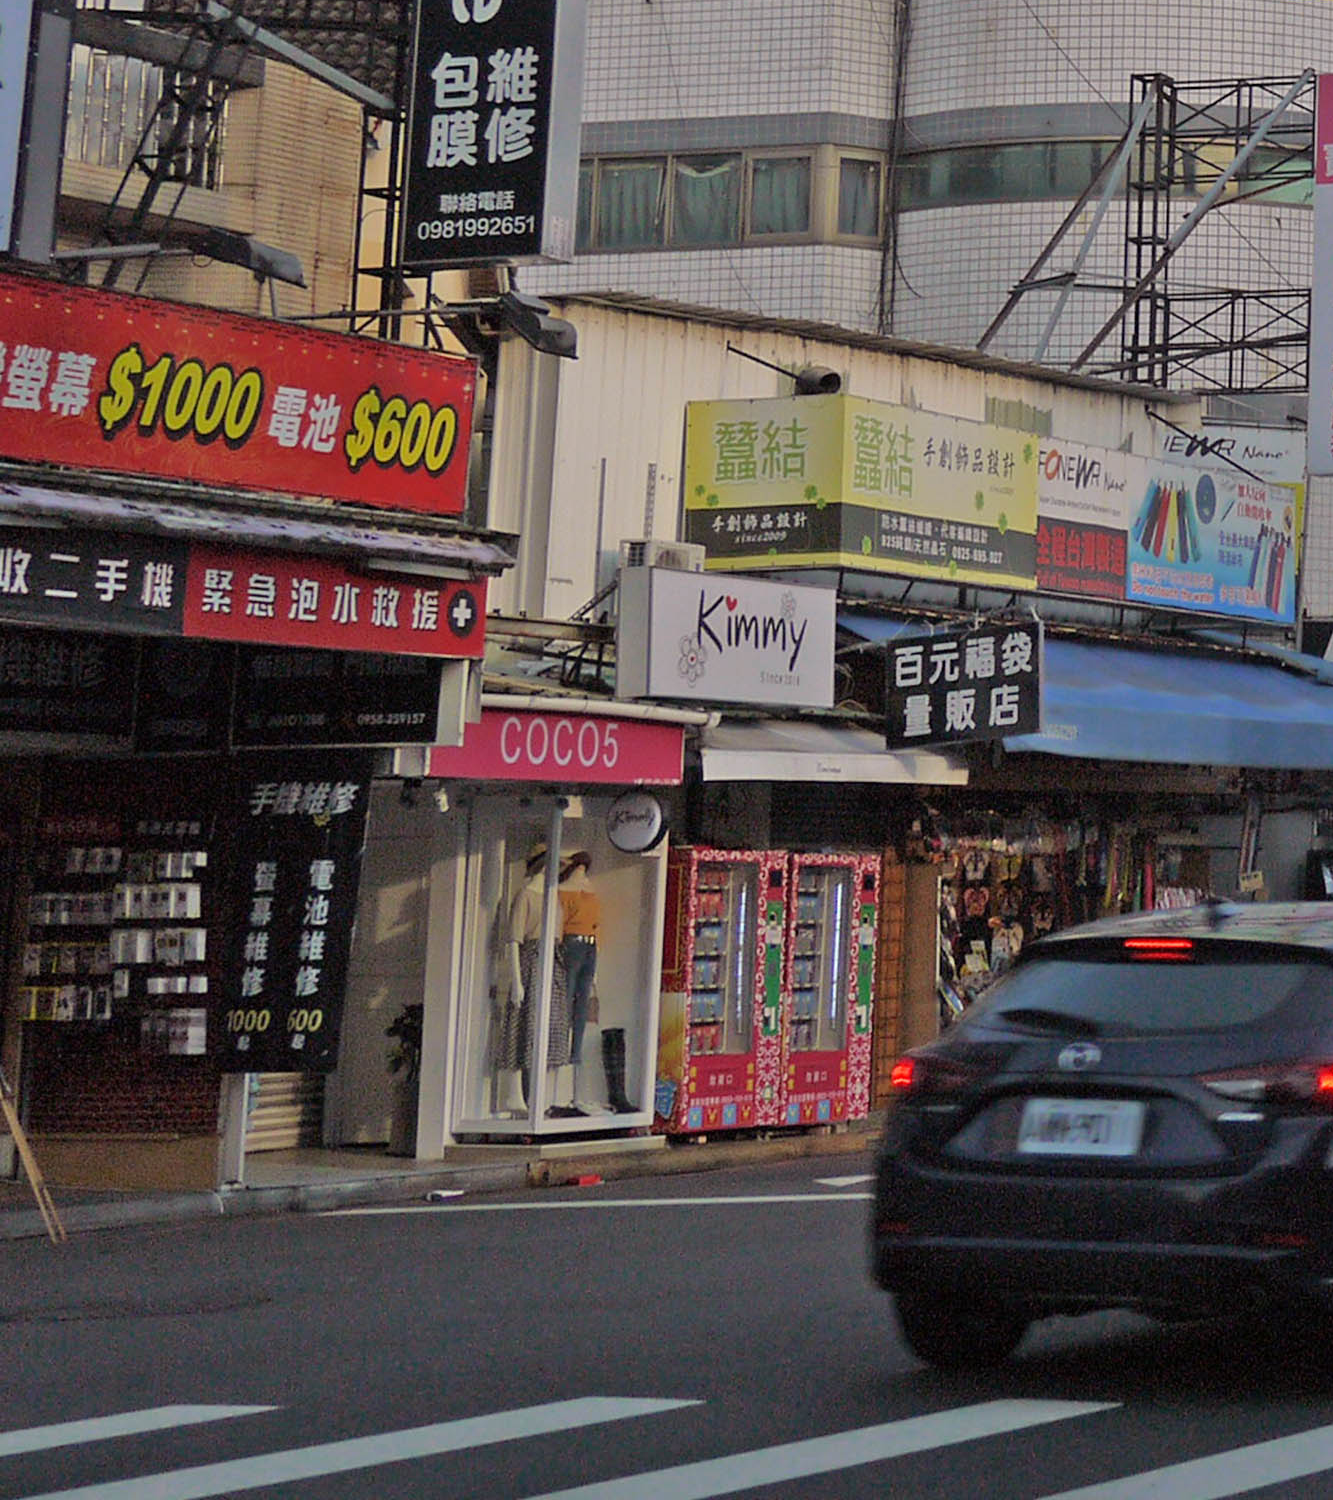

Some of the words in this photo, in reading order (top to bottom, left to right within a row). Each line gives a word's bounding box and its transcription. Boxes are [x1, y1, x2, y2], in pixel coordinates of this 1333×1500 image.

[426, 51, 479, 169] 包膜
[485, 46, 540, 163] 維修
[416, 215, 535, 241] 0981992651
[440, 190, 516, 214] 聯絡電話
[100, 345, 263, 443] $1000
[268, 385, 341, 454] 電池
[346, 388, 458, 473] $600
[924, 437, 1016, 478] 手創飾品設計
[711, 512, 808, 534] 手創飾品設計
[202, 568, 440, 632] 緊急泡水救援
[698, 590, 808, 671] Kimmy
[893, 633, 1032, 687] 百元福袋
[903, 685, 1020, 738] 量販店
[501, 716, 619, 768] COCO5
[249, 780, 360, 816] 手機維修
[295, 859, 335, 998] 電池維修
[225, 1009, 271, 1035] 1000
[287, 1008, 323, 1035] 600
